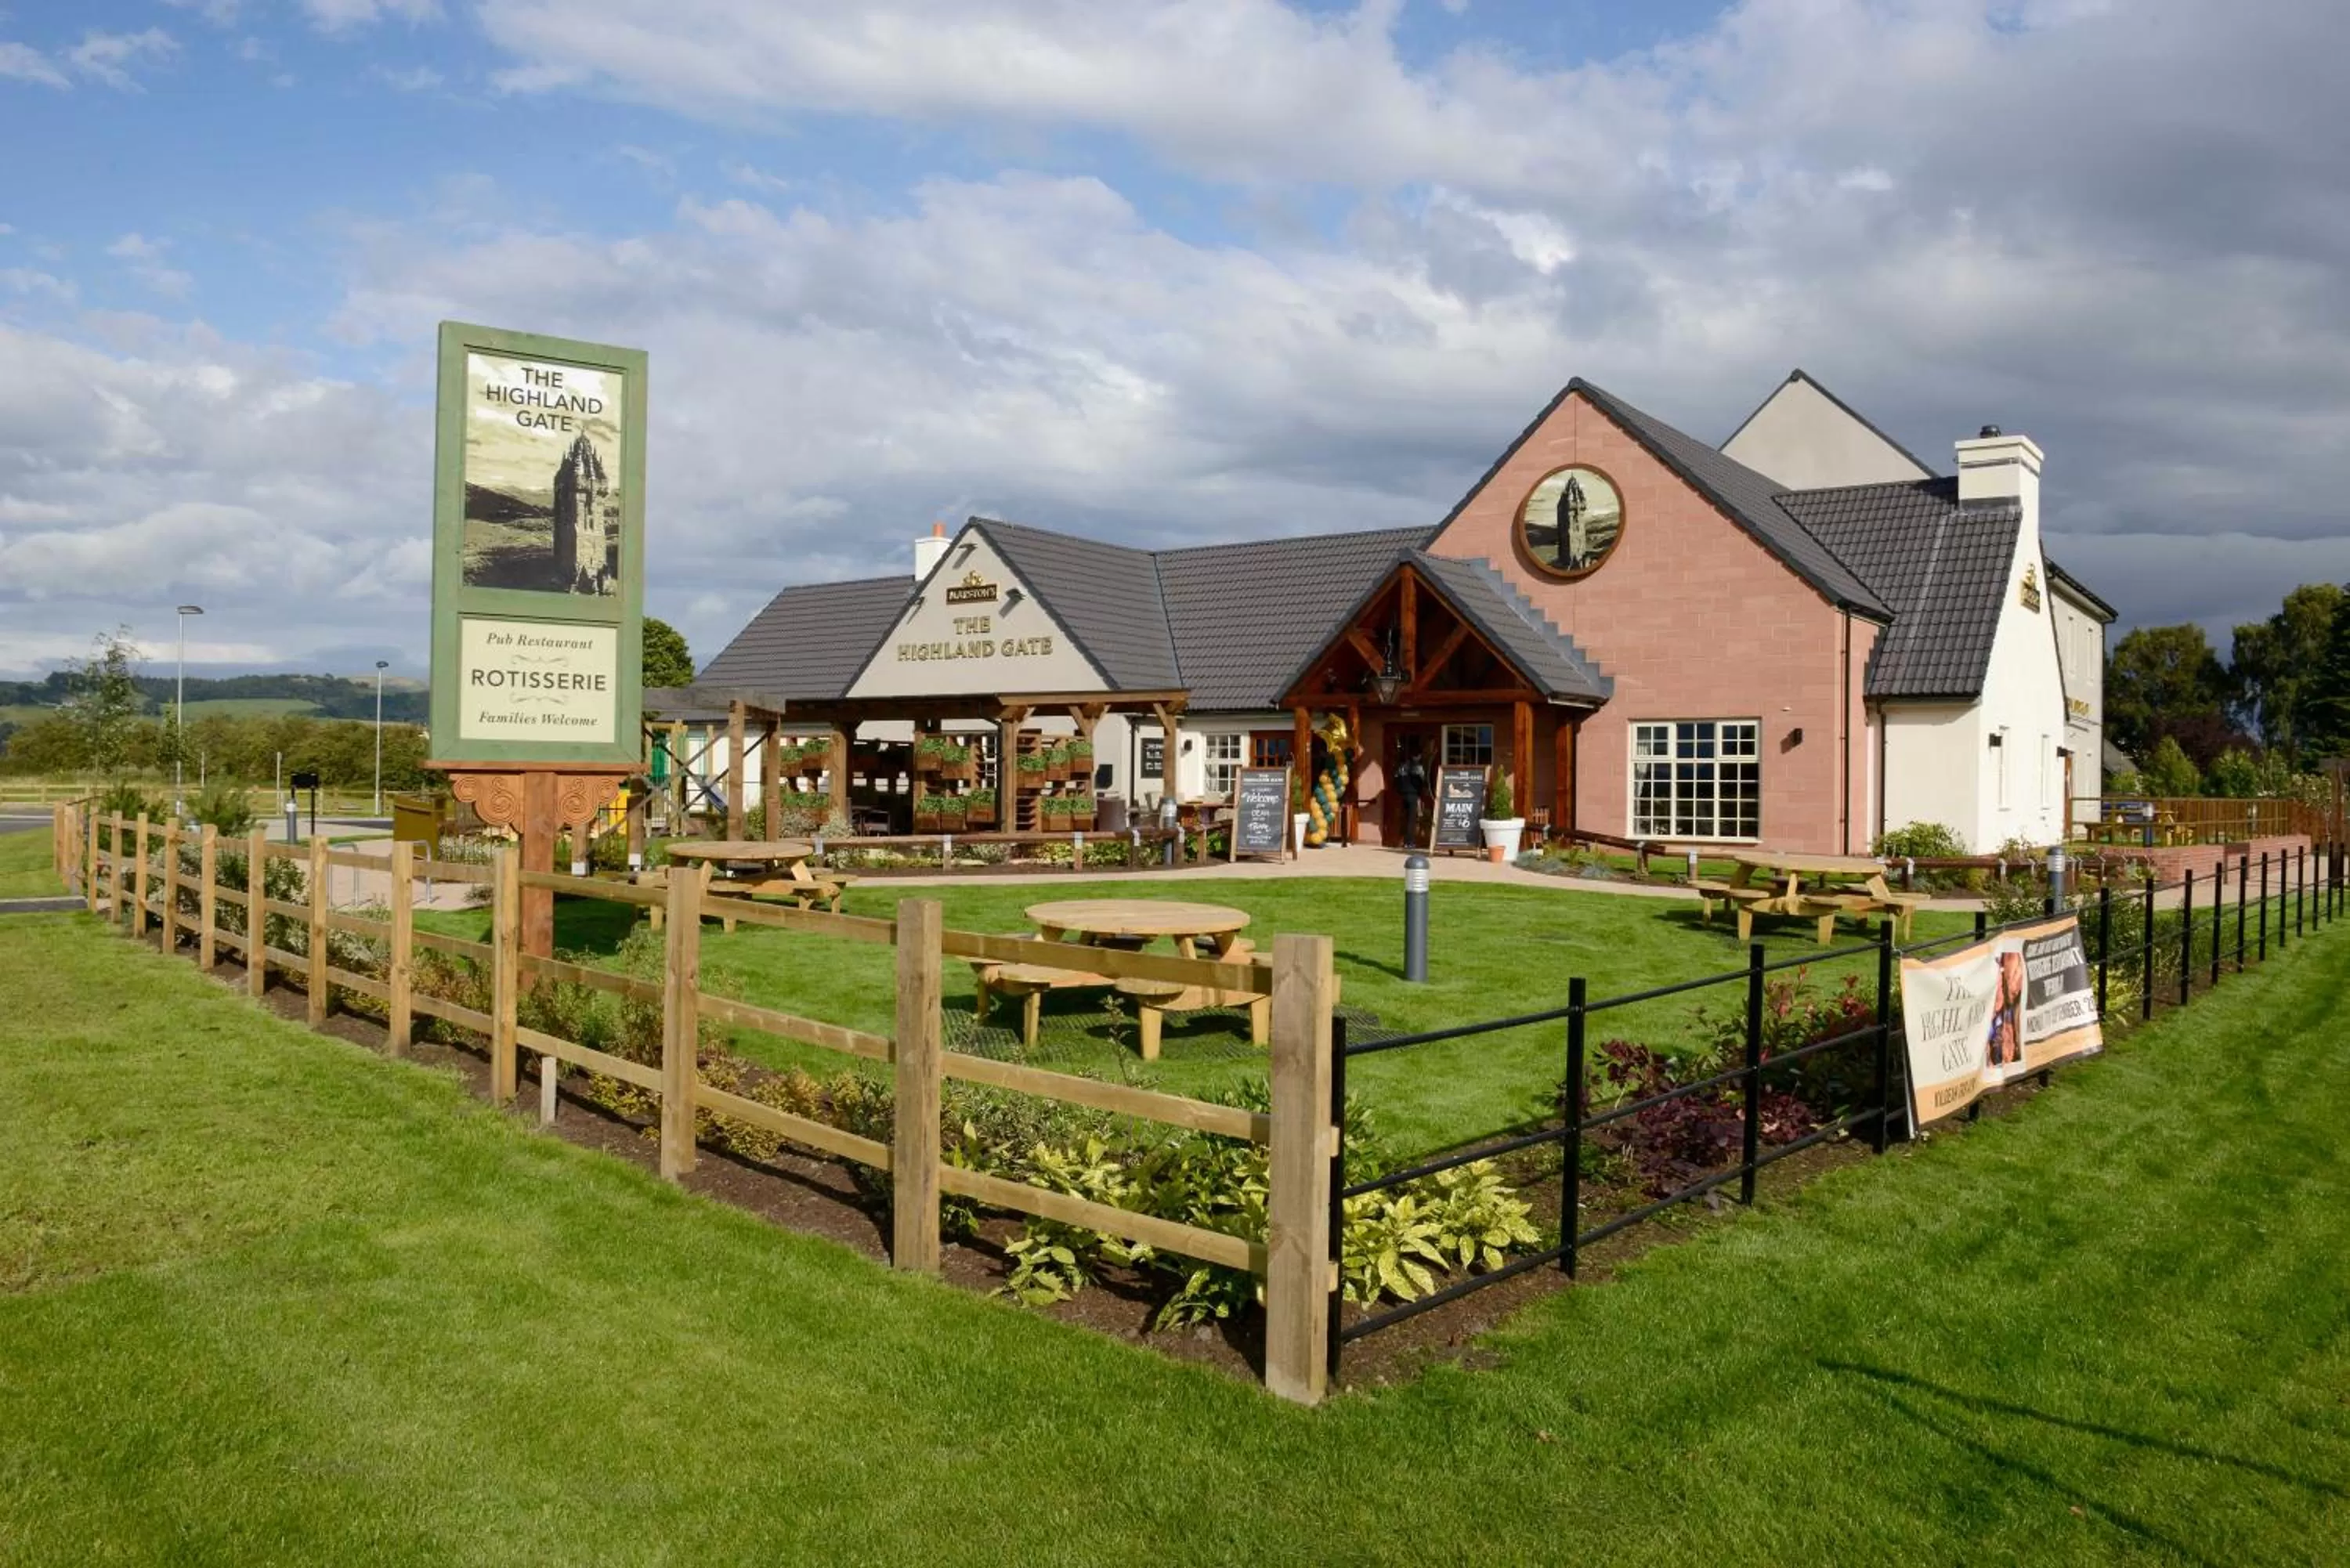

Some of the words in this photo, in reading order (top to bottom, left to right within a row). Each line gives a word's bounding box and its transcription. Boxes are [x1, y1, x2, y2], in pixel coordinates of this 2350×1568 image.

[522, 367, 563, 389] THE
[486, 384, 603, 414] HIGHLAND
[516, 410, 573, 432] GATE
[953, 616, 991, 635] THE
[486, 632, 513, 645] Pub
[517, 634, 594, 649] Restaurant
[897, 640, 996, 662] HIGHLAND
[1000, 636, 1054, 657] GATE
[471, 668, 607, 691] ROTISSERIE
[479, 710, 537, 724] Families
[541, 714, 598, 726] Welcome
[1445, 803, 1473, 813] MAIN
